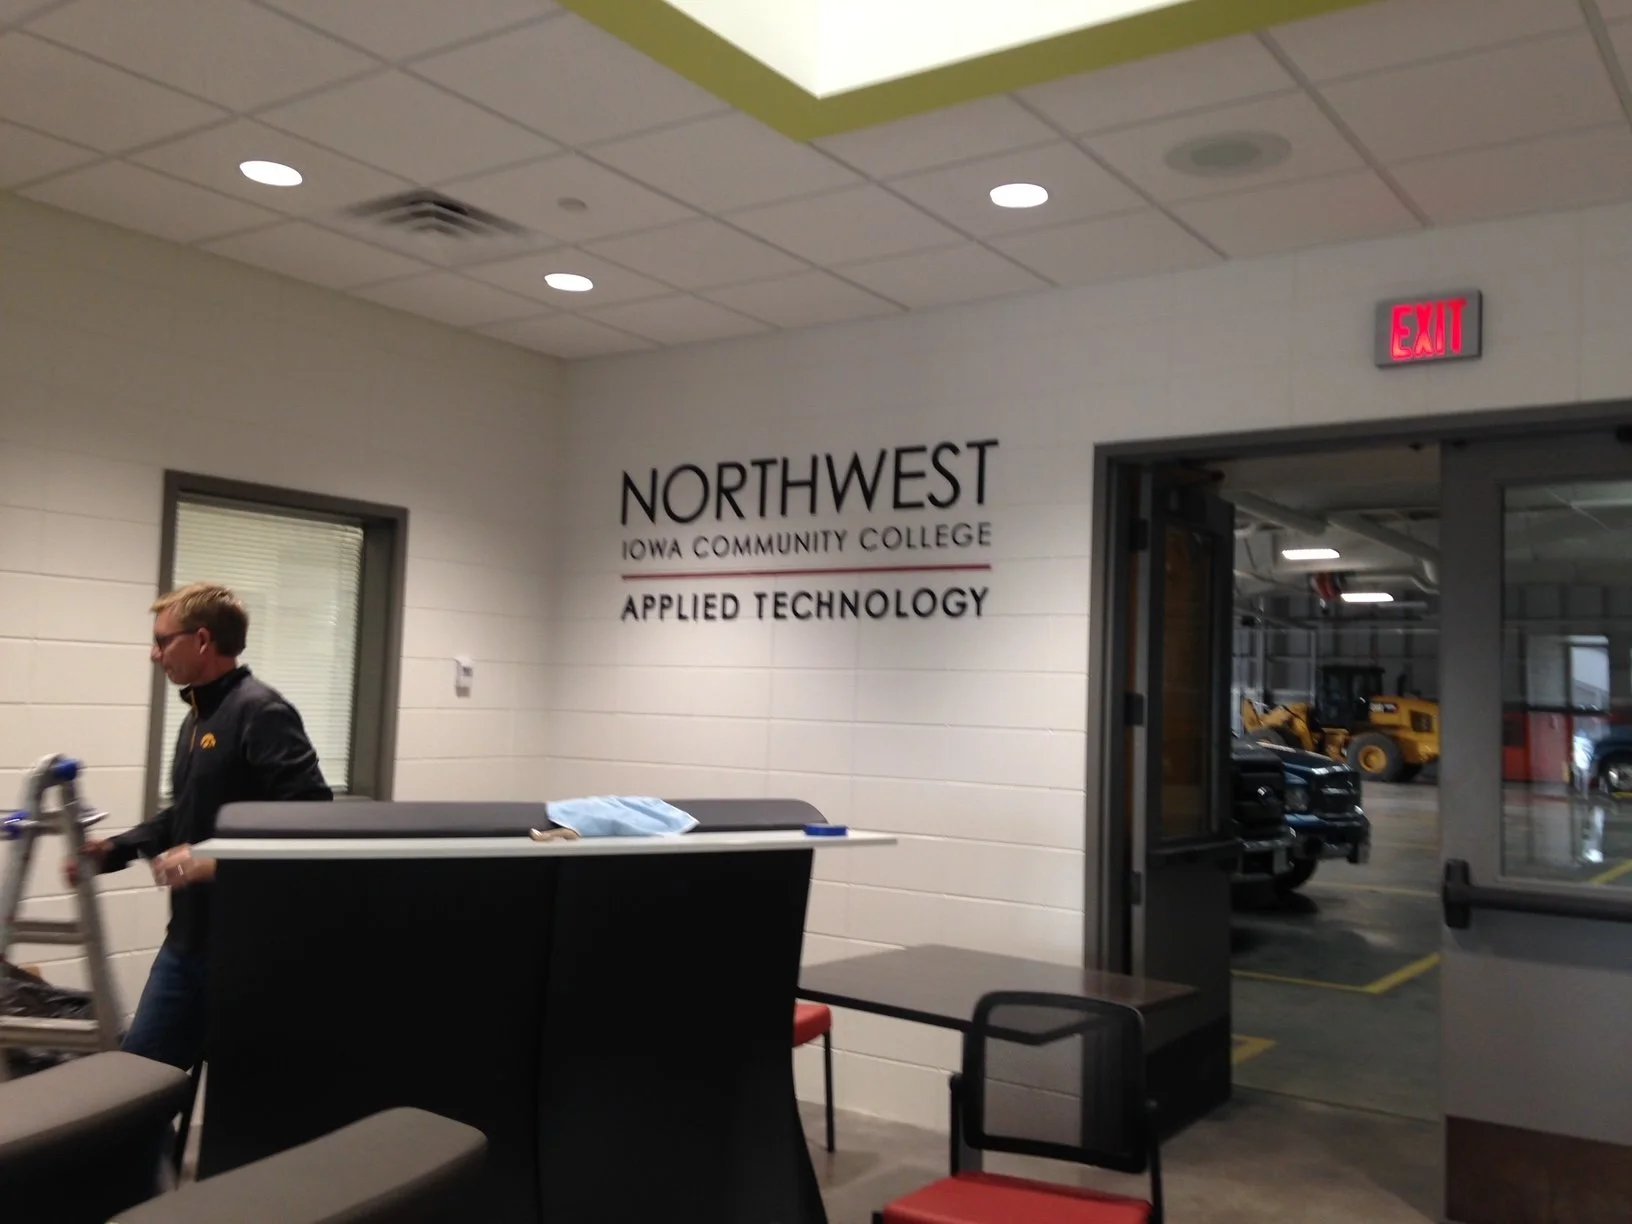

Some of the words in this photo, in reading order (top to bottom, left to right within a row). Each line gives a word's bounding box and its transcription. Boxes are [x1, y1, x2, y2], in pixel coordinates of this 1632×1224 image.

[1391, 298, 1467, 361] EXIT
[620, 438, 999, 526] NORTHWEST
[621, 536, 683, 561] IOWA
[692, 529, 848, 558] COMMUNITY
[859, 521, 992, 552] COLLEGE
[620, 593, 741, 622] APPLIED
[753, 585, 990, 621] TECHNOLOGY
